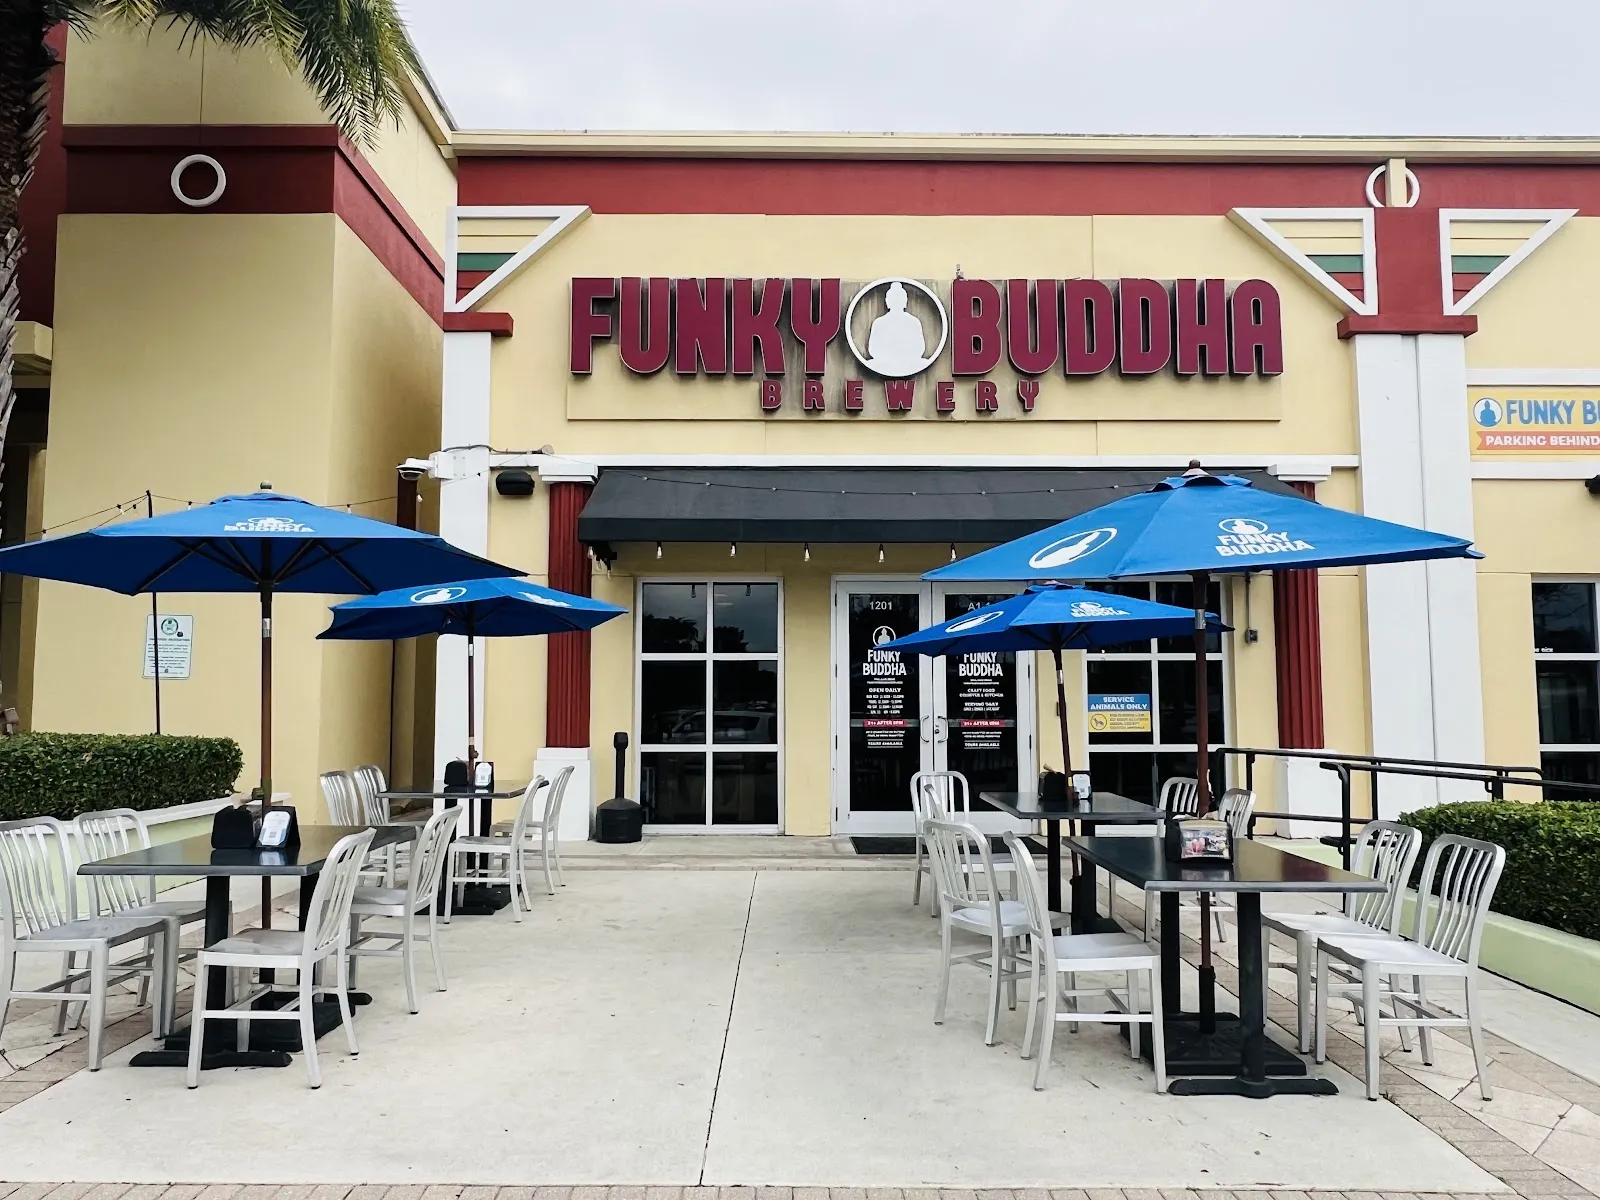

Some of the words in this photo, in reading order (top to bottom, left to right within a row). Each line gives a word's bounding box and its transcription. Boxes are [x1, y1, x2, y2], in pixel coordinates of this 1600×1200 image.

[571, 277, 840, 375] FUNKY
[951, 278, 1284, 377] BUDDHA
[761, 379, 1040, 412] BREWERY
[1506, 400, 1575, 425] FUNKY
[1582, 400, 1600, 425] B
[1485, 435, 1547, 446] PARKING
[1549, 435, 1600, 446] BEHIND
[224, 525, 316, 533] BUDDHA
[1217, 531, 1290, 546] FUNKY
[1215, 540, 1316, 557] BUDDHA
[869, 601, 893, 610] 1201
[867, 649, 901, 662] FUNKY
[963, 651, 998, 663] FUNKY
[862, 663, 907, 676] BUDDHA
[958, 664, 1004, 677] BUDDHA
